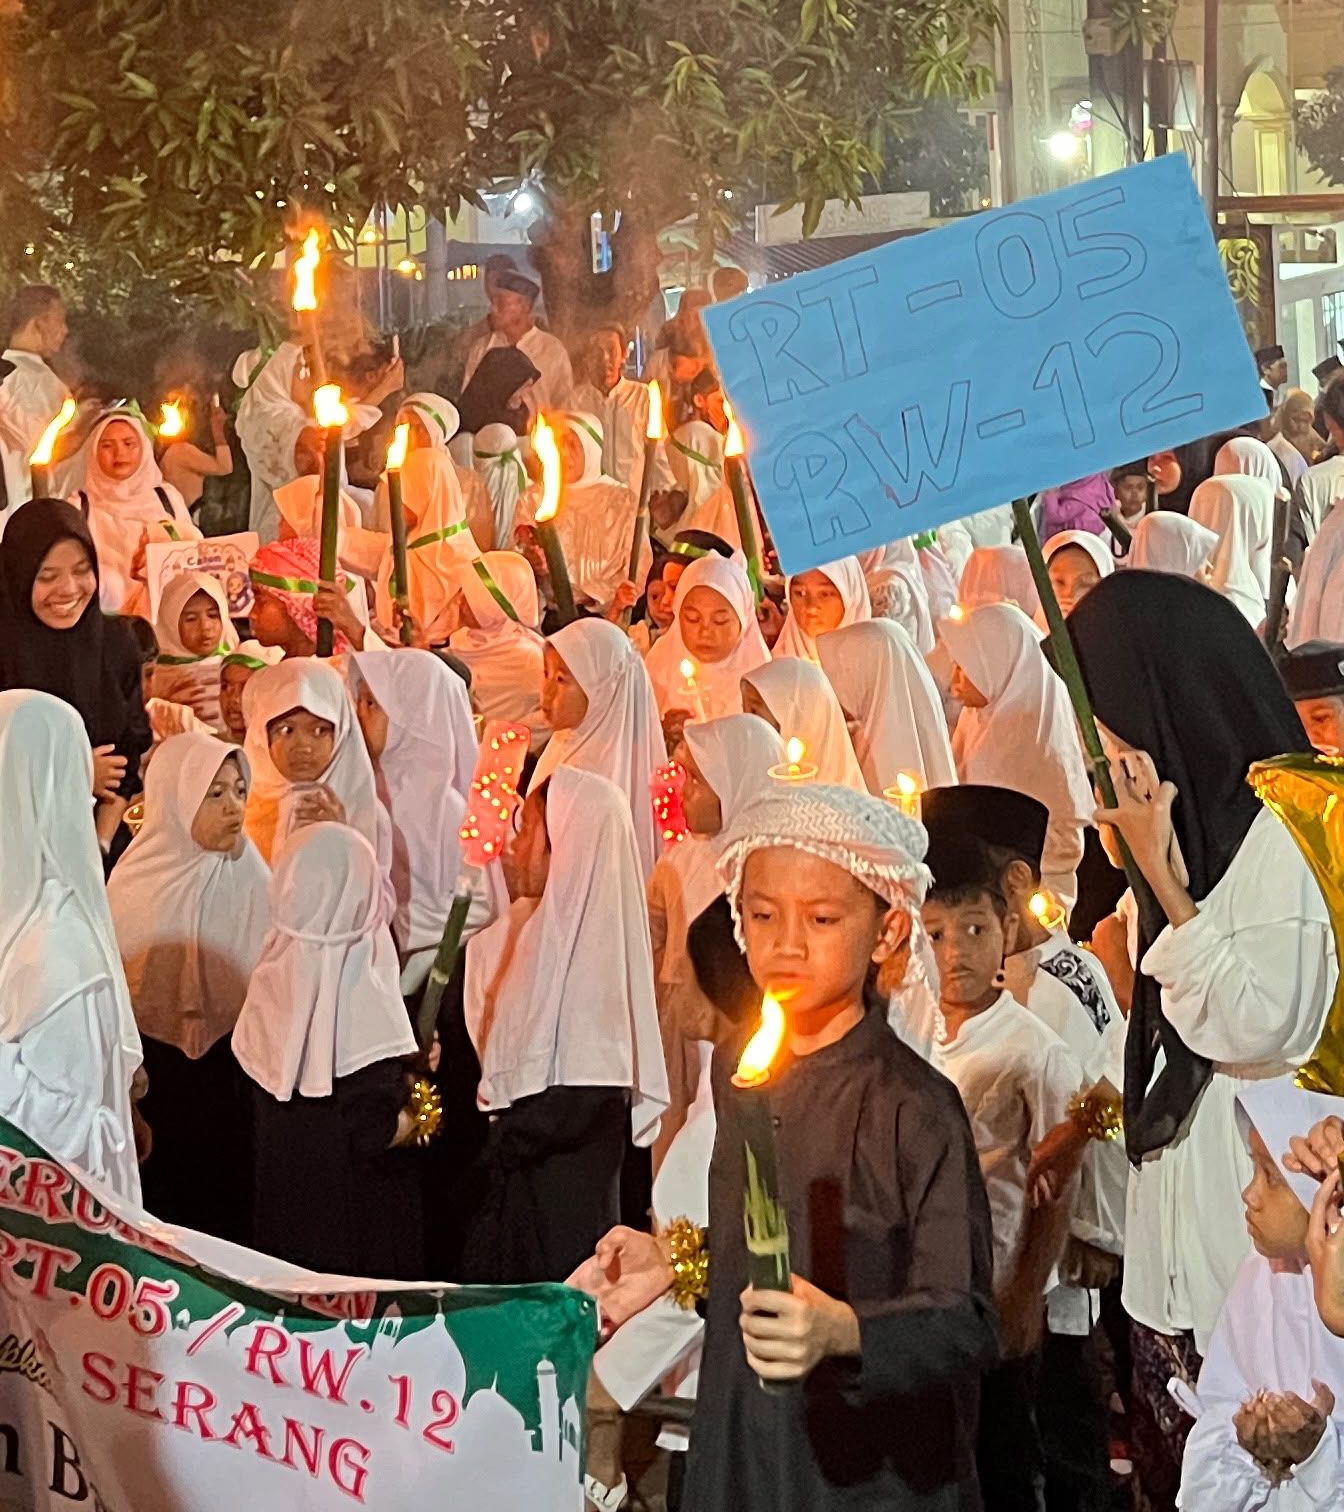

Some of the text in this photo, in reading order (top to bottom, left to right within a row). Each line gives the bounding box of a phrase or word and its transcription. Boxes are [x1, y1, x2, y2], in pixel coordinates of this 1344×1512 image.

[773, 312, 1203, 547] RW-12
[82, 1351, 372, 1505] SERANG
[244, 1324, 460, 1455] RW.12
